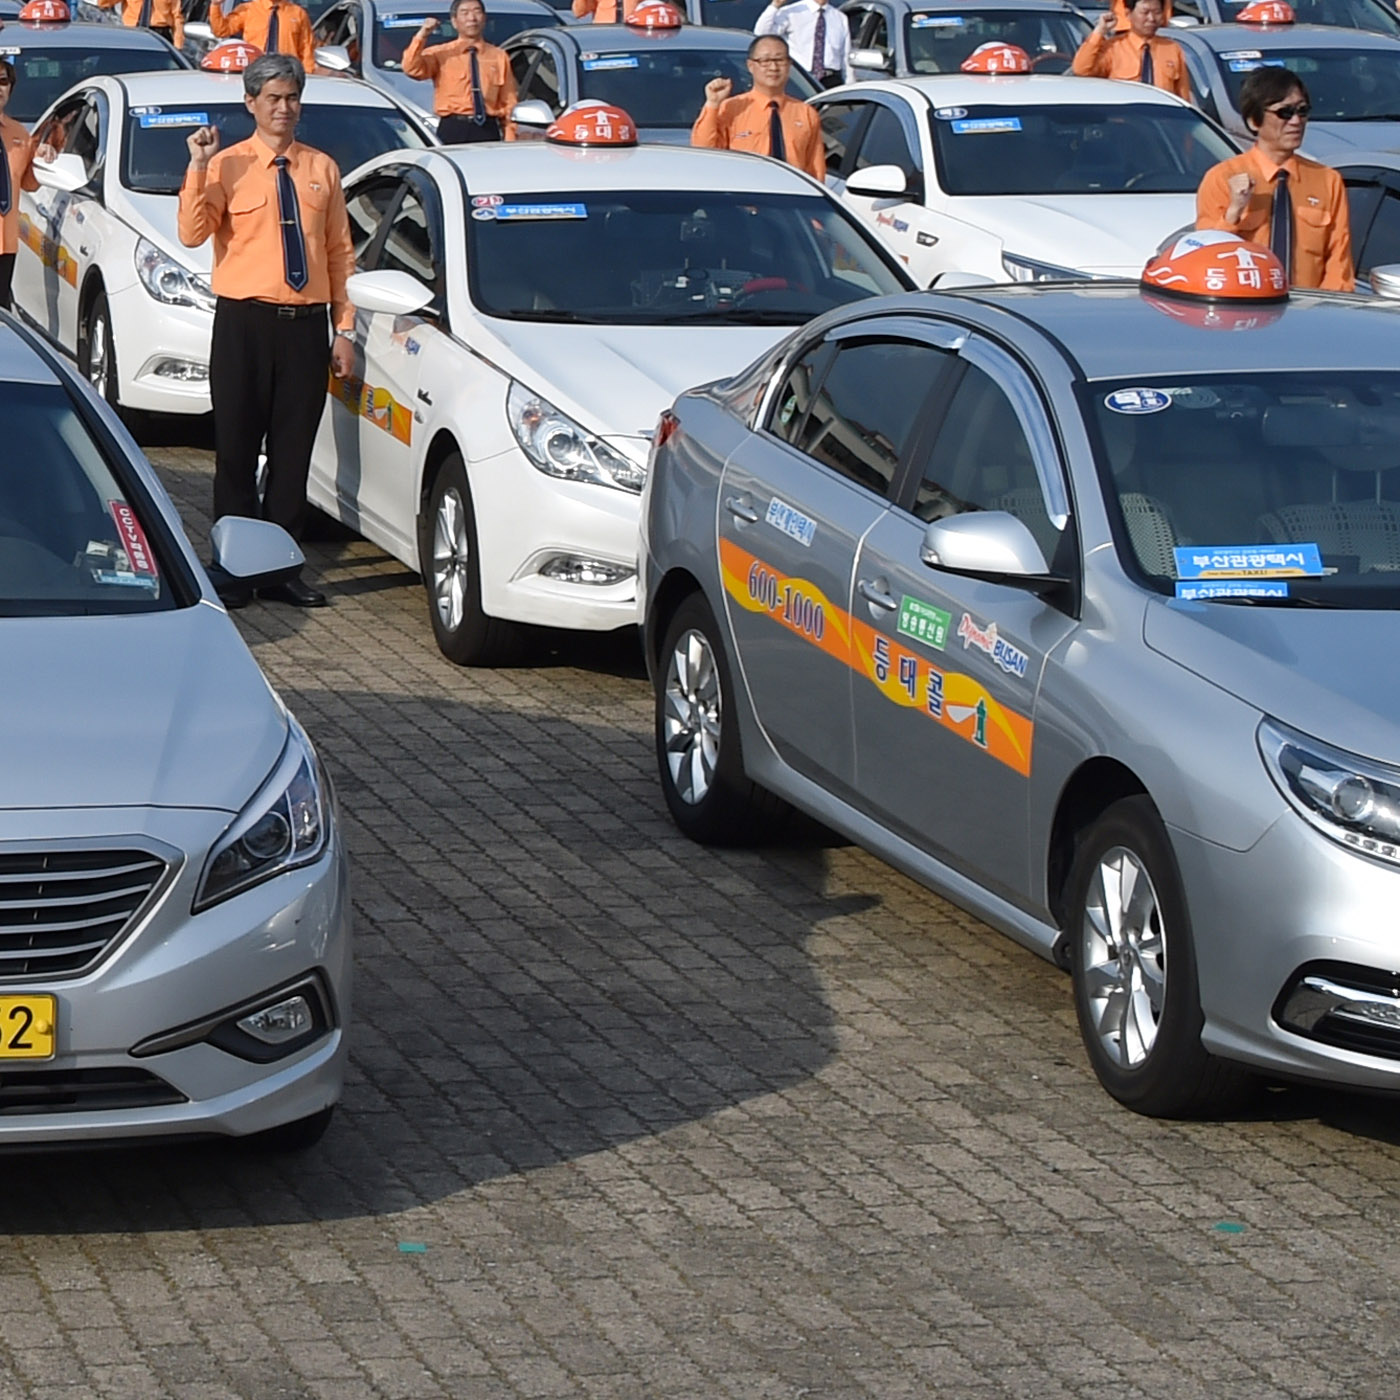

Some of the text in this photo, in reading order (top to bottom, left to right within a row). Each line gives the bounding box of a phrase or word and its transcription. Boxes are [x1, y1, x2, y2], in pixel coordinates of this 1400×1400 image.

[1204, 268, 1283, 291] 등대콜
[1192, 552, 1305, 568] 부산관광택시
[748, 561, 825, 642] 600-1000
[993, 639, 1028, 676] BUSAN
[873, 636, 945, 718] 등대콜
